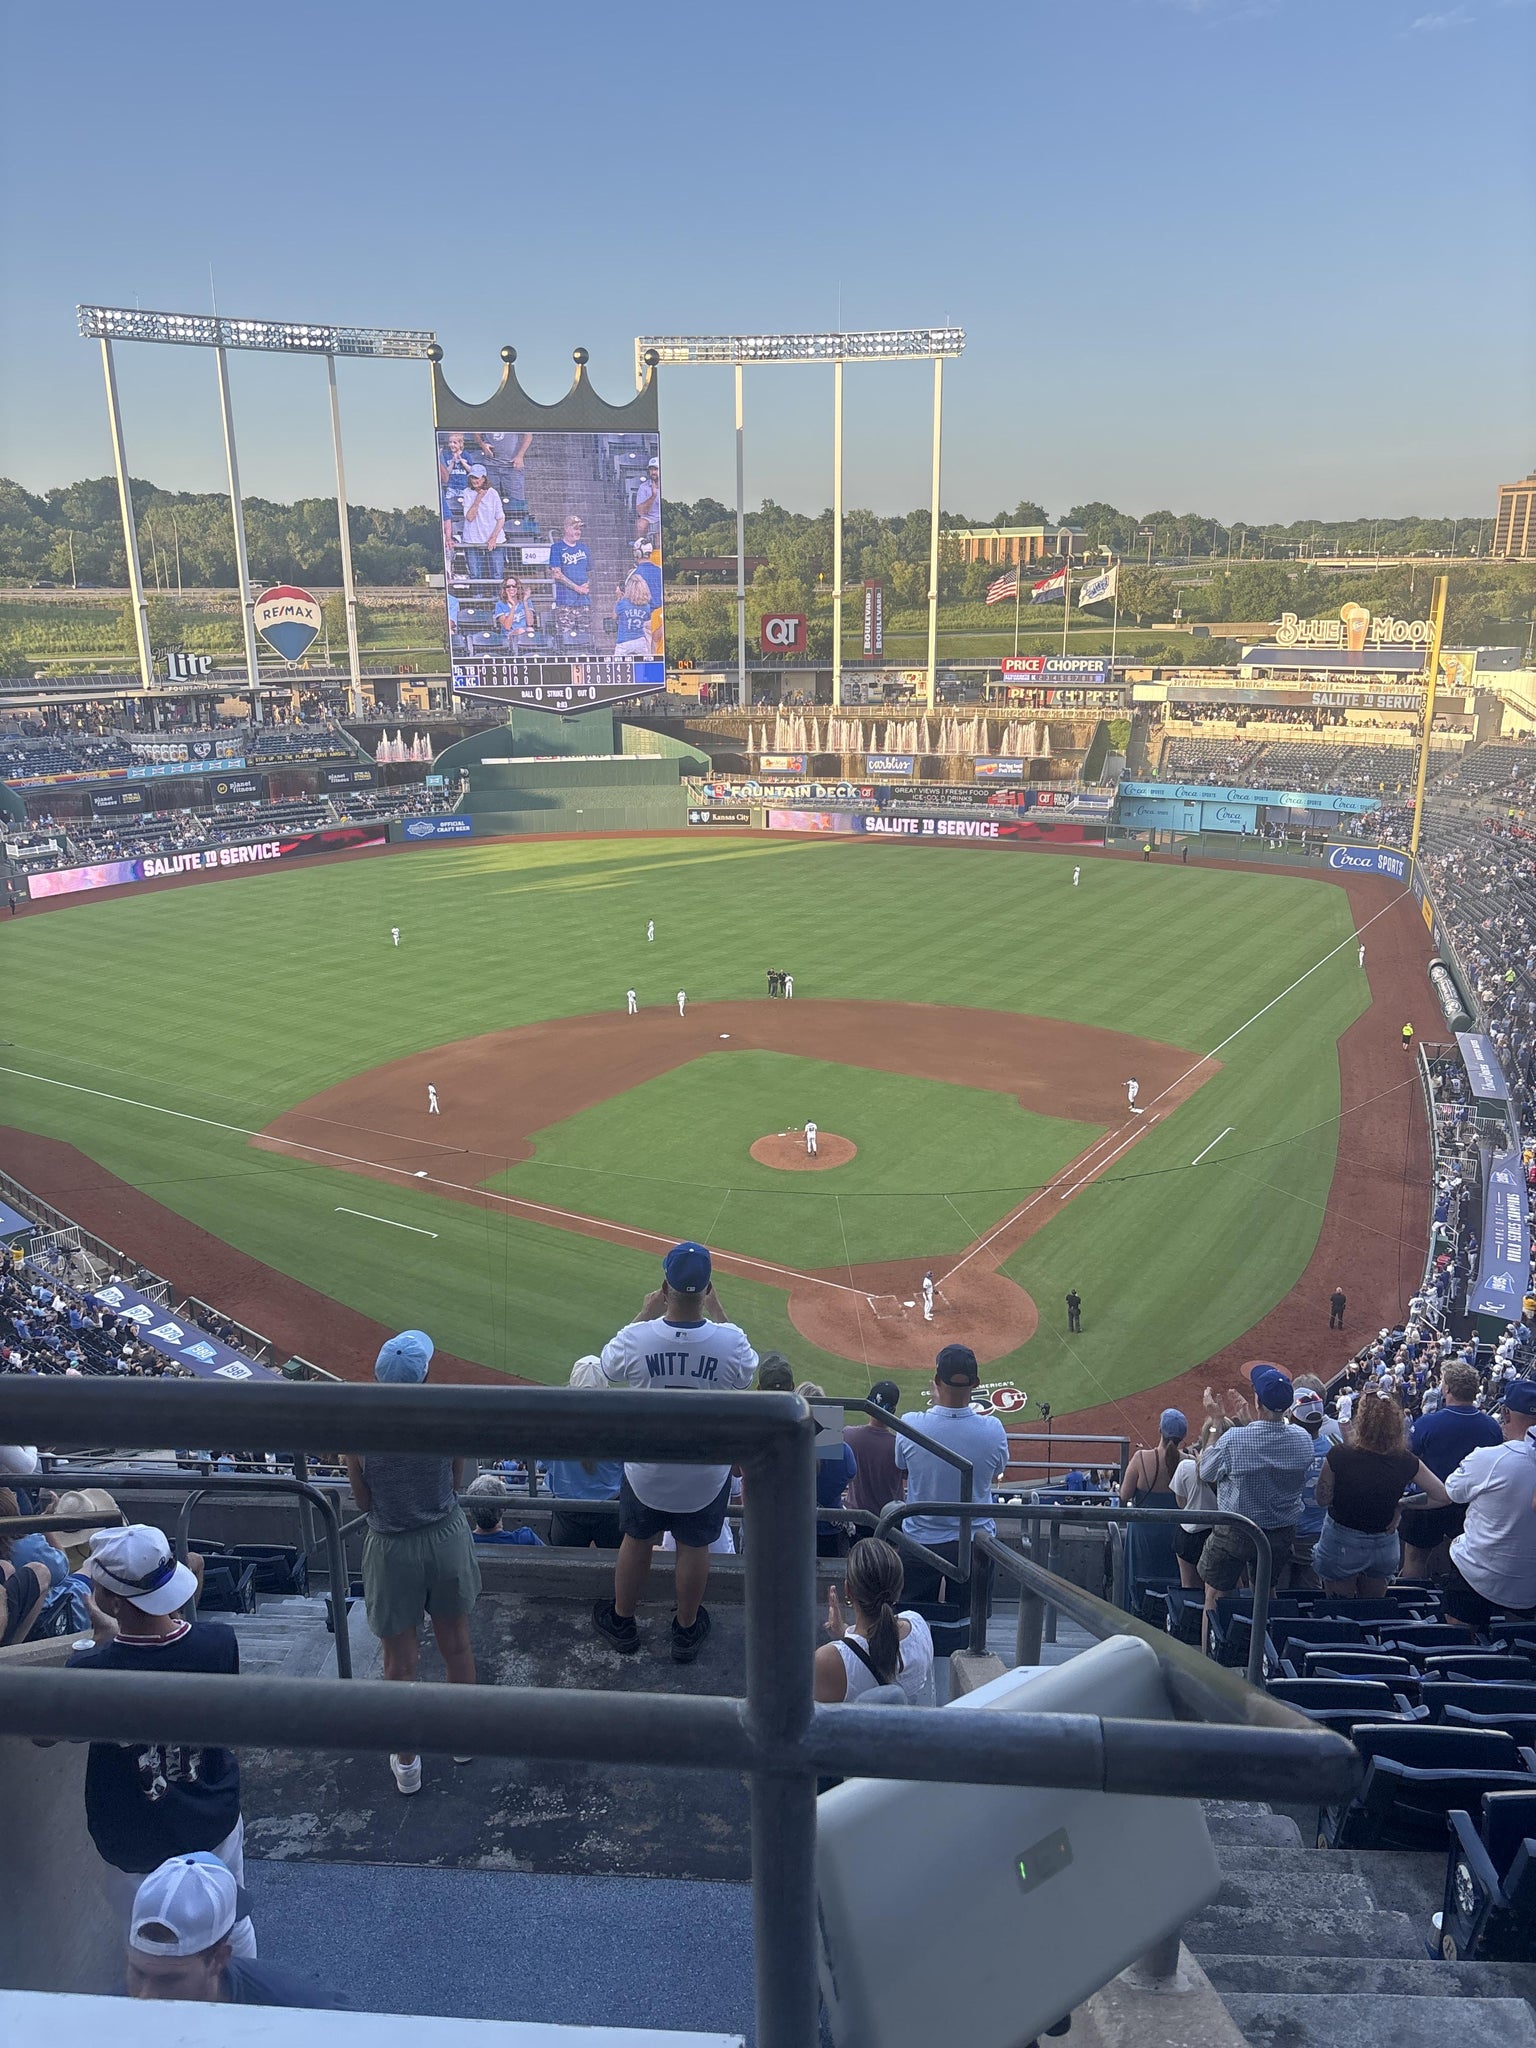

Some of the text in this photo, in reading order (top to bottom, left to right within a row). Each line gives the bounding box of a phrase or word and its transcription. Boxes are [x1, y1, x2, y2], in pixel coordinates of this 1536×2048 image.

[562, 550, 587, 565] Royals
[263, 606, 313, 621] RE/MAX
[625, 608, 647, 619] PEREZ
[864, 592, 873, 649] BOULEVARD
[874, 592, 883, 649] BOULEVARD
[766, 618, 799, 646] QT
[1276, 612, 1340, 646] BLUE
[167, 652, 212, 682] Lite
[466, 666, 475, 675] TB
[492, 666, 497, 675] 3
[503, 666, 507, 675] 0
[514, 666, 518, 674] 0
[524, 666, 528, 674] 2
[576, 665, 580, 673] 5
[587, 665, 591, 673] 8
[606, 665, 610, 673] 5
[627, 664, 631, 672] 2
[1006, 660, 1104, 672] PRICE CHOPPER
[466, 678, 476, 687] KC
[493, 677, 497, 685] 0
[503, 677, 507, 685] 0
[514, 676, 518, 684] 0
[524, 676, 528, 684] 0
[587, 675, 591, 683] 2
[597, 675, 600, 683] 0
[607, 675, 611, 683] 3
[617, 675, 621, 683] 3
[627, 675, 631, 683] 2
[535, 687, 542, 700] 0
[547, 690, 564, 698] STRIKE
[565, 687, 572, 700] 0
[589, 686, 596, 699] 0
[1312, 693, 1421, 709] SALUTE TO SERVIC
[869, 756, 910, 770] carbliss
[230, 781, 251, 789] planet
[1124, 784, 1147, 796] Circa
[731, 786, 857, 798] FOUNTAIN DECK
[1040, 794, 1051, 803] QT
[1175, 786, 1198, 798] Circa
[1227, 790, 1250, 801] Circa
[94, 796, 112, 804] planet
[1280, 793, 1303, 805] Circa
[1332, 798, 1357, 810] Circa
[736, 813, 749, 822] City
[1138, 806, 1154, 816] Circa
[1216, 806, 1242, 820] Circa
[866, 816, 999, 838] SALUTE TO SERVICE
[143, 842, 280, 876] SALUTE TO SERVICE
[1330, 846, 1404, 876] Circa SPORTS
[102, 1289, 120, 1302] 1976
[128, 1307, 149, 1320] 1977
[158, 1325, 181, 1340] 1978
[224, 1365, 246, 1378] 1981
[646, 1352, 718, 1382] WITT JR.
